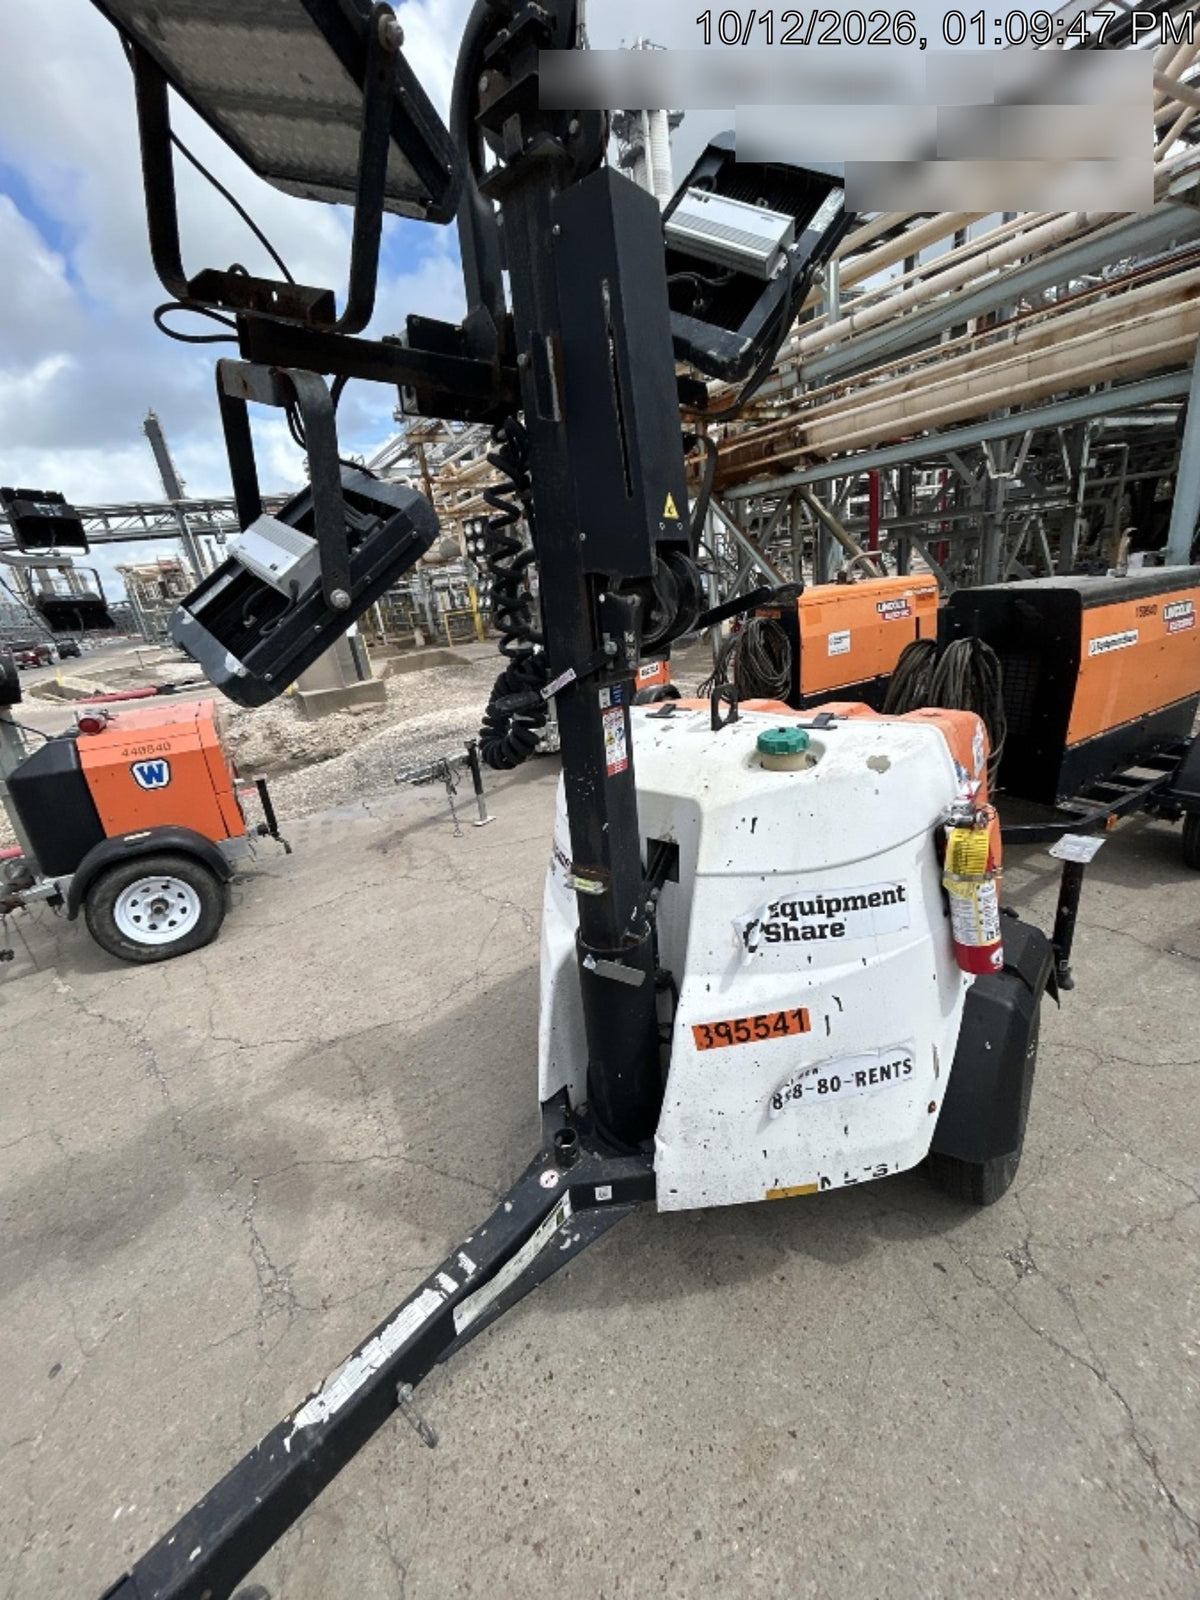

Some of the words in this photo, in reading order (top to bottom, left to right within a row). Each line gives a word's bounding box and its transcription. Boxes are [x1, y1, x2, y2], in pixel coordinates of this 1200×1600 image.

[767, 884, 907, 922] Equipment
[764, 921, 846, 943] Share
[699, 1007, 806, 1050] 395541
